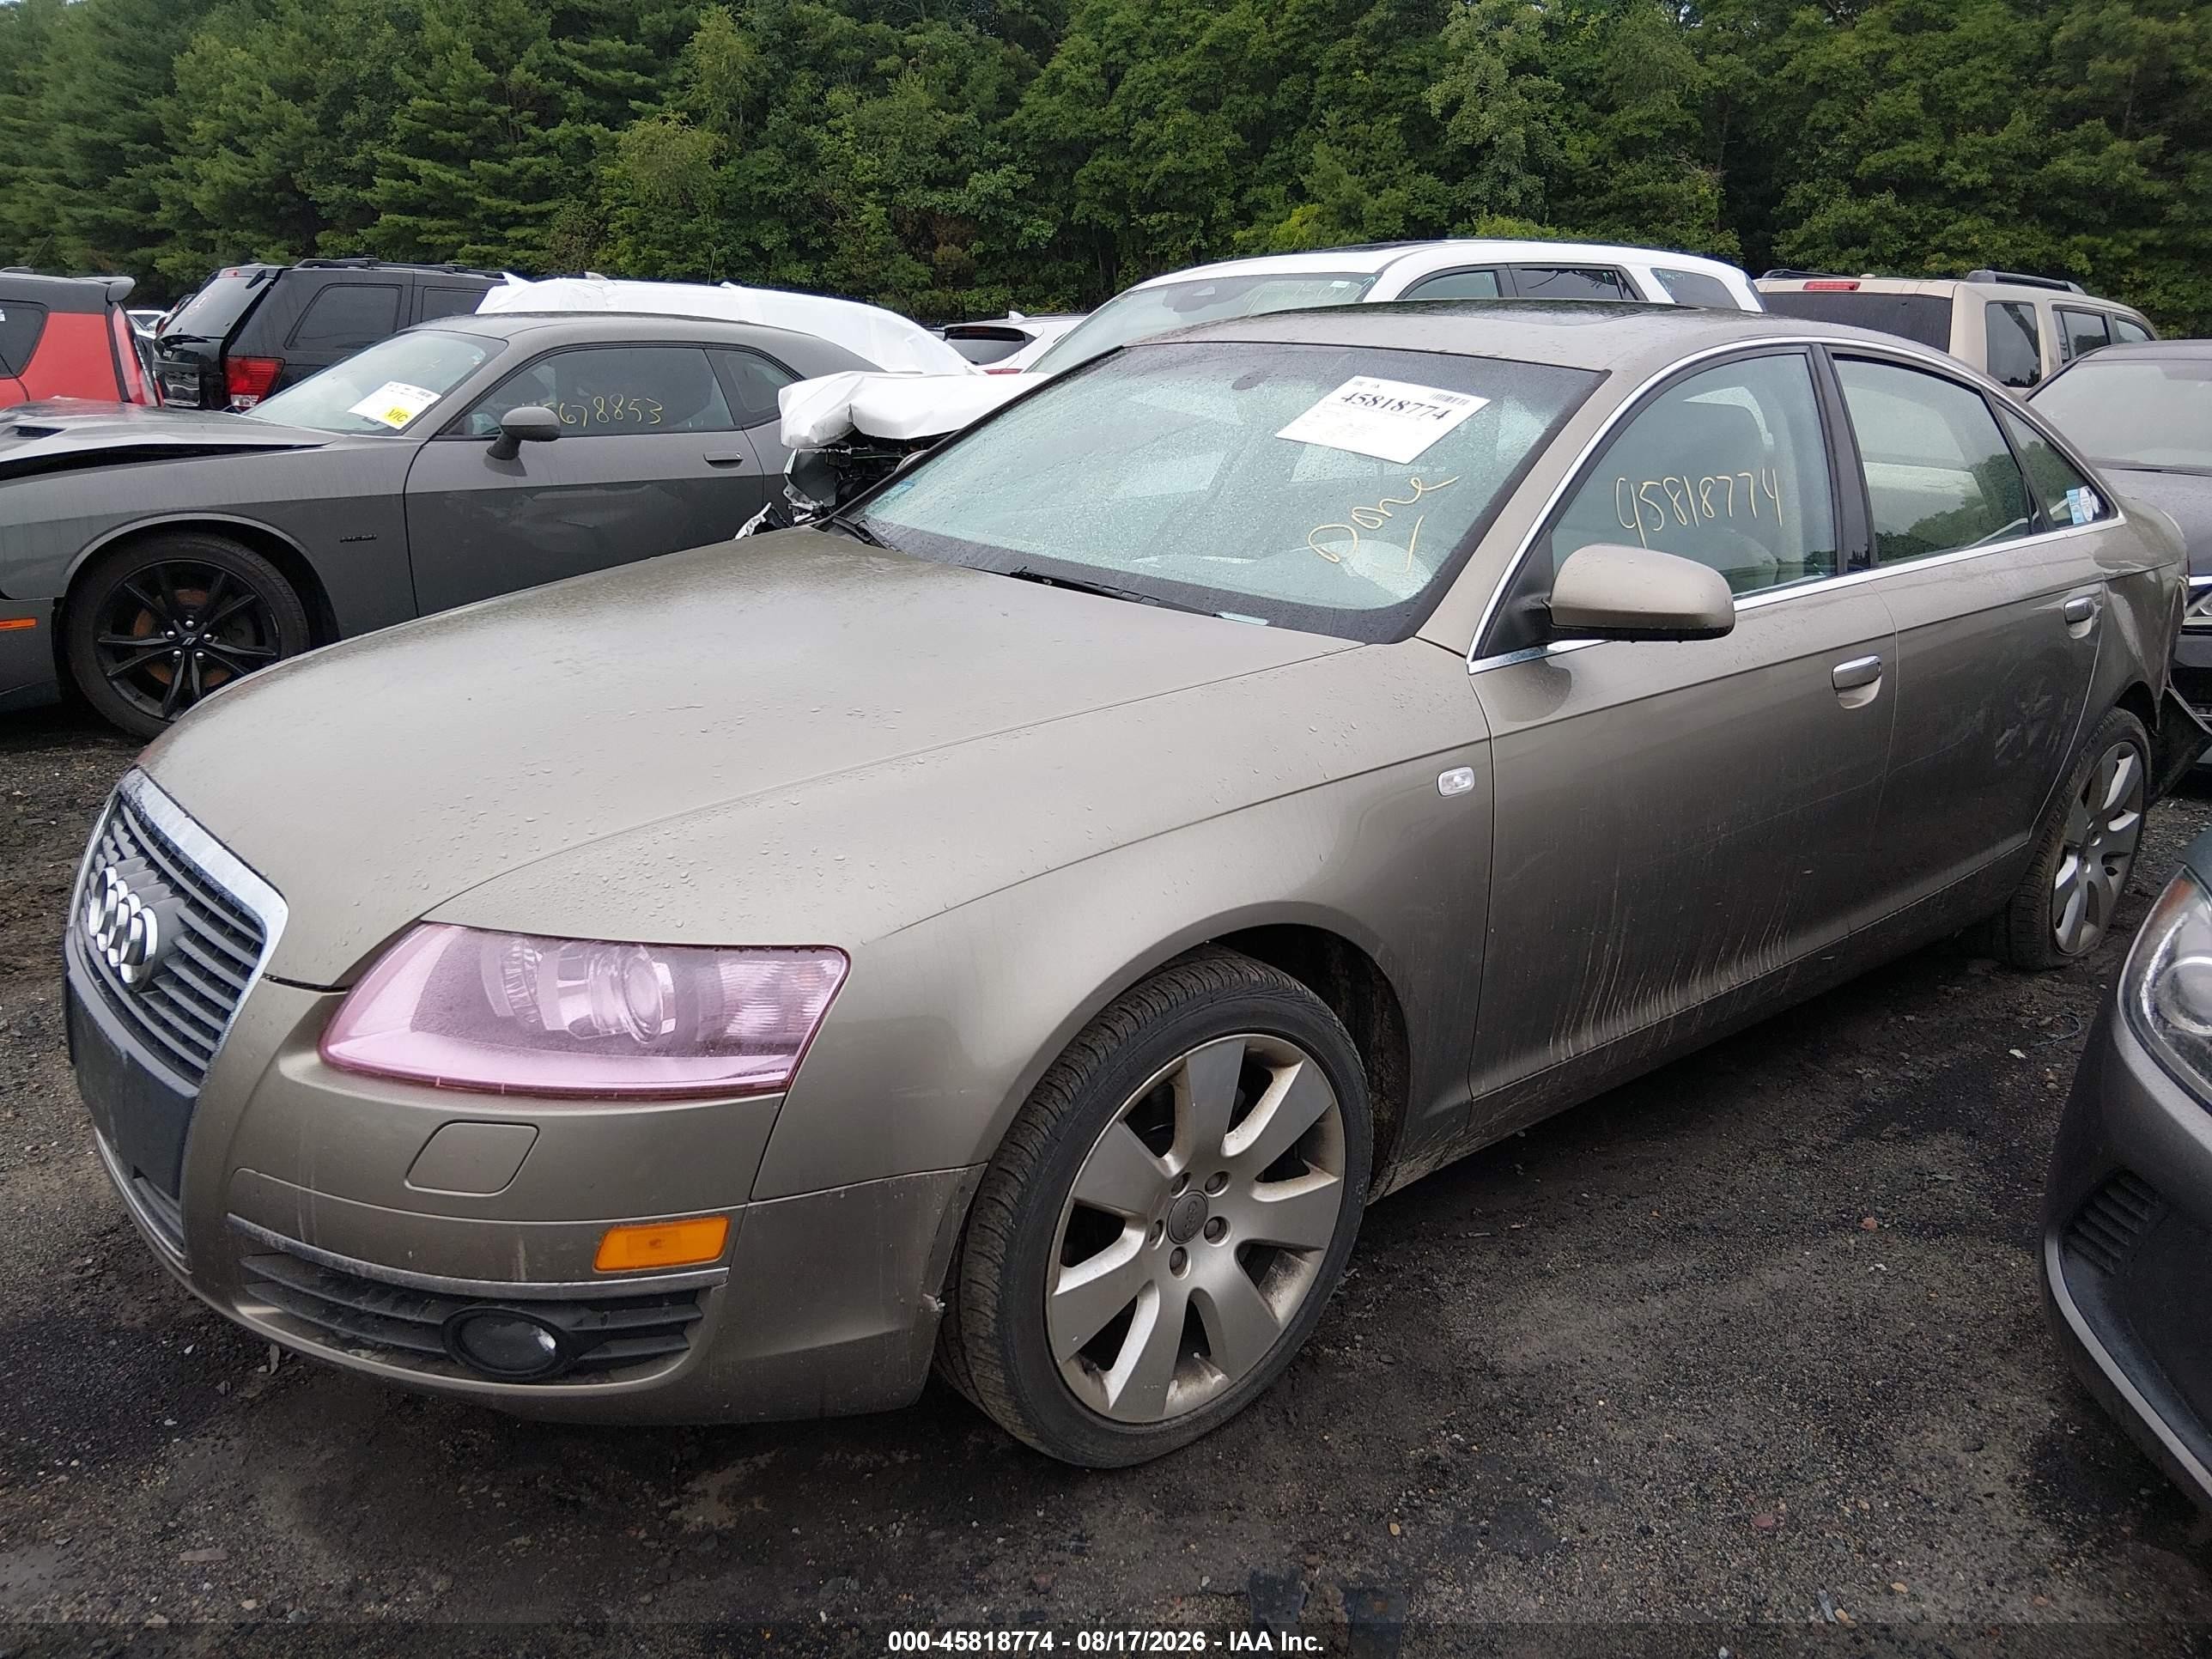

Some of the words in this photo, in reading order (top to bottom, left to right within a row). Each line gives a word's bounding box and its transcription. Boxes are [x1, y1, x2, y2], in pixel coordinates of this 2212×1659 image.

[387, 408, 410, 422] VIC
[539, 392, 664, 428] 678853
[1340, 392, 1452, 421] 45818774
[1615, 467, 1783, 549] 45818774
